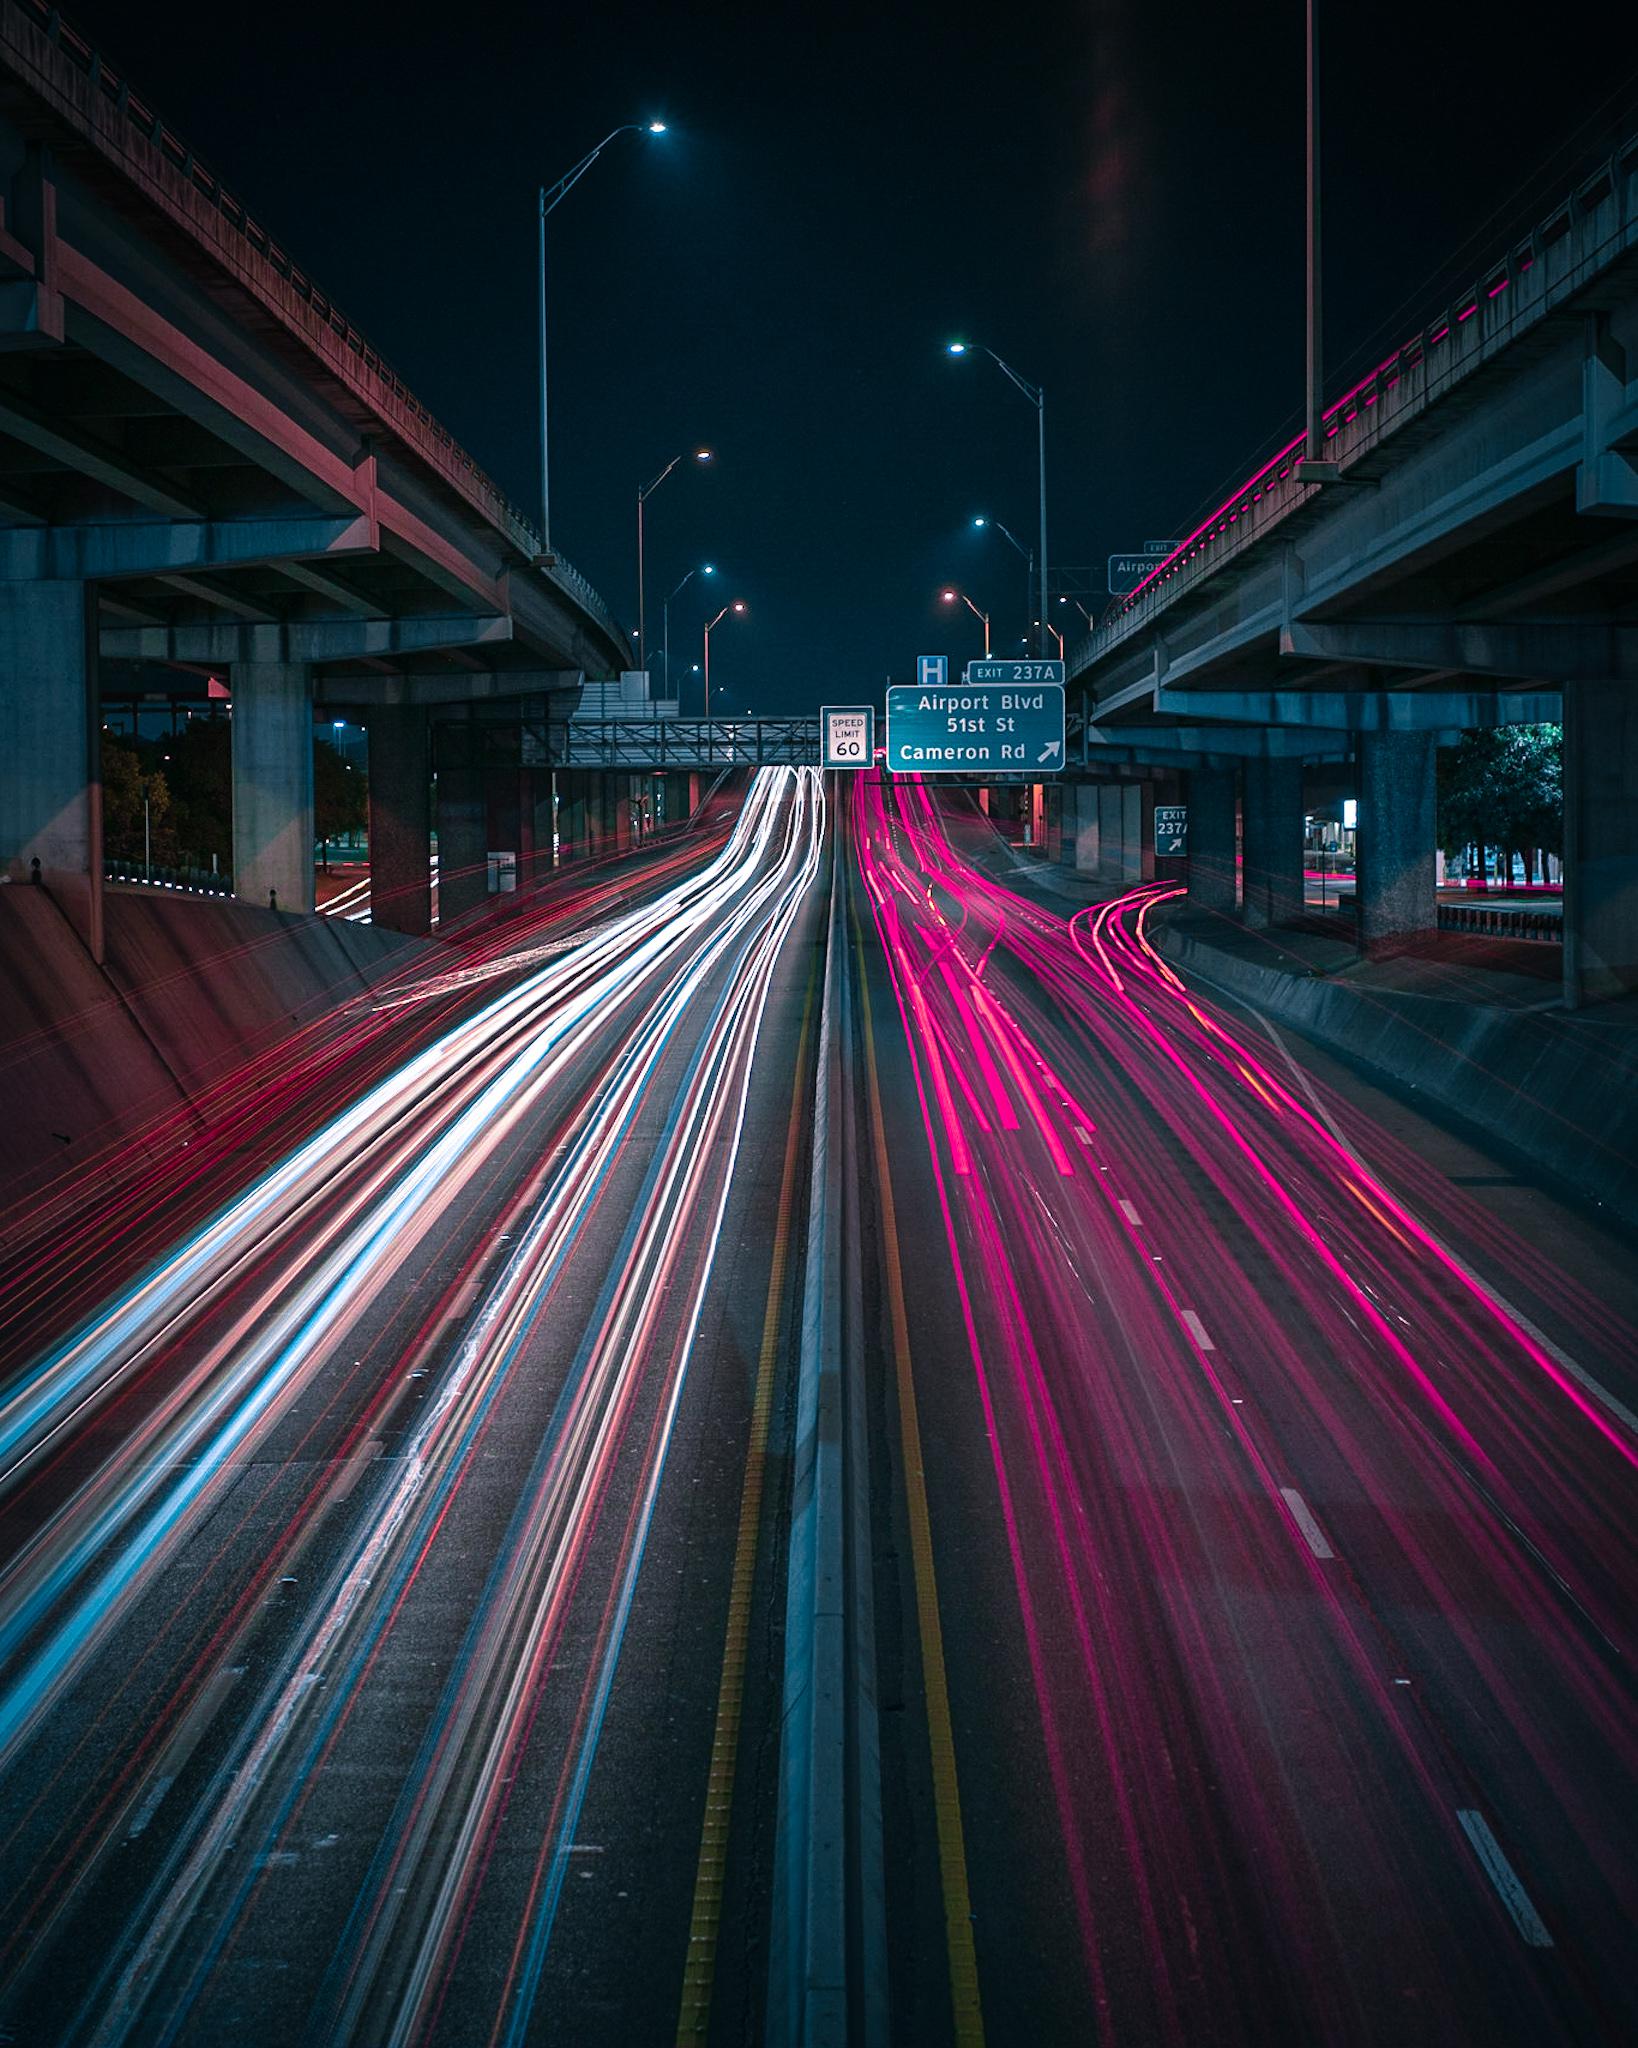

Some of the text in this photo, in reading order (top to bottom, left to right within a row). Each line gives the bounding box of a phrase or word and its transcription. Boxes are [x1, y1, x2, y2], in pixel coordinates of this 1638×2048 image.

[1117, 561, 1158, 574] Airpo
[922, 658, 943, 684] H
[977, 665, 1055, 680] EXIT 237A
[918, 694, 1044, 713] Airport Blvd
[832, 719, 864, 728] SPEED
[947, 717, 1015, 733] 51st St
[835, 730, 860, 738] LIMIT
[836, 742, 860, 756] 60
[900, 744, 1026, 760] Cameron Rd
[1162, 811, 1187, 820] EXIT
